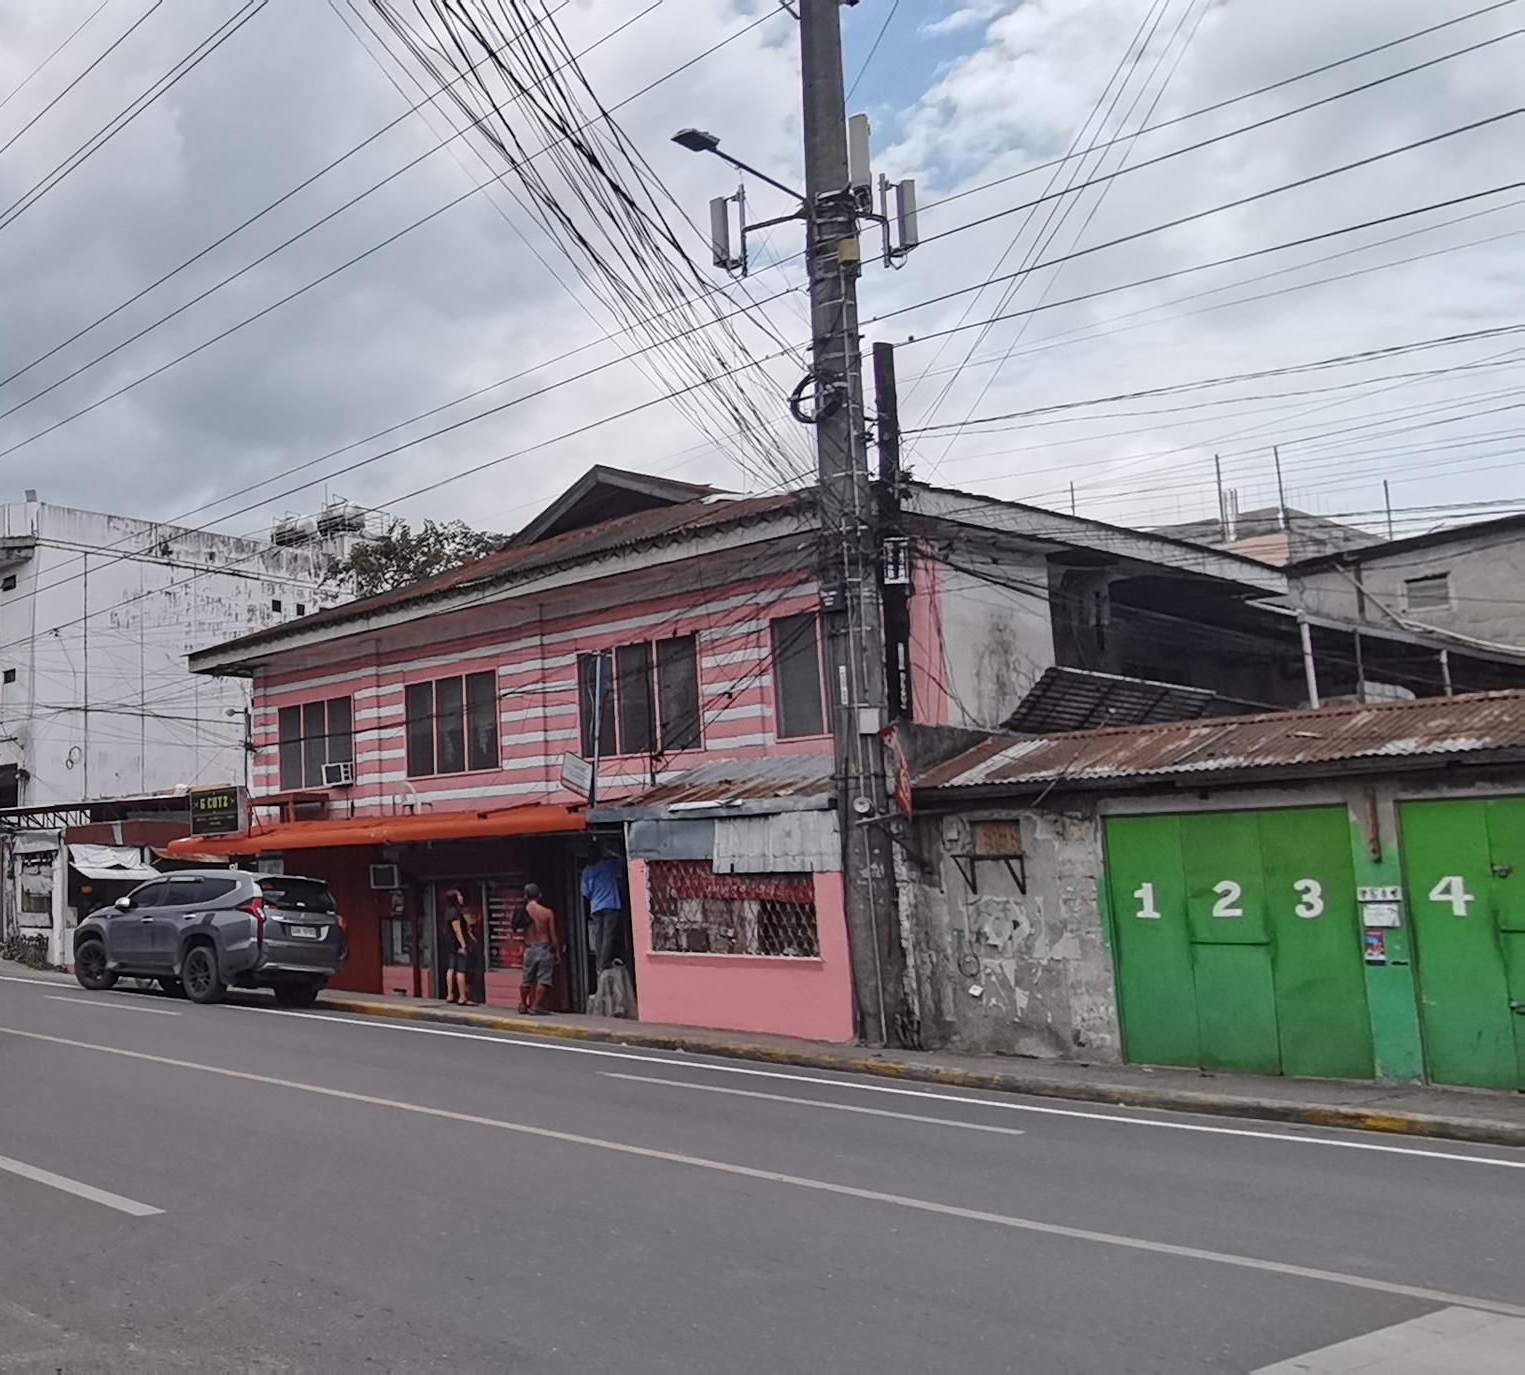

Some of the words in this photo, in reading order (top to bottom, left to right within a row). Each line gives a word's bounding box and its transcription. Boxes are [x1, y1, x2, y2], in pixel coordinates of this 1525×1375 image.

[1133, 882, 1161, 919] 1
[1212, 880, 1243, 917] 2
[1293, 879, 1324, 918] 3
[1429, 876, 1474, 917] 4
